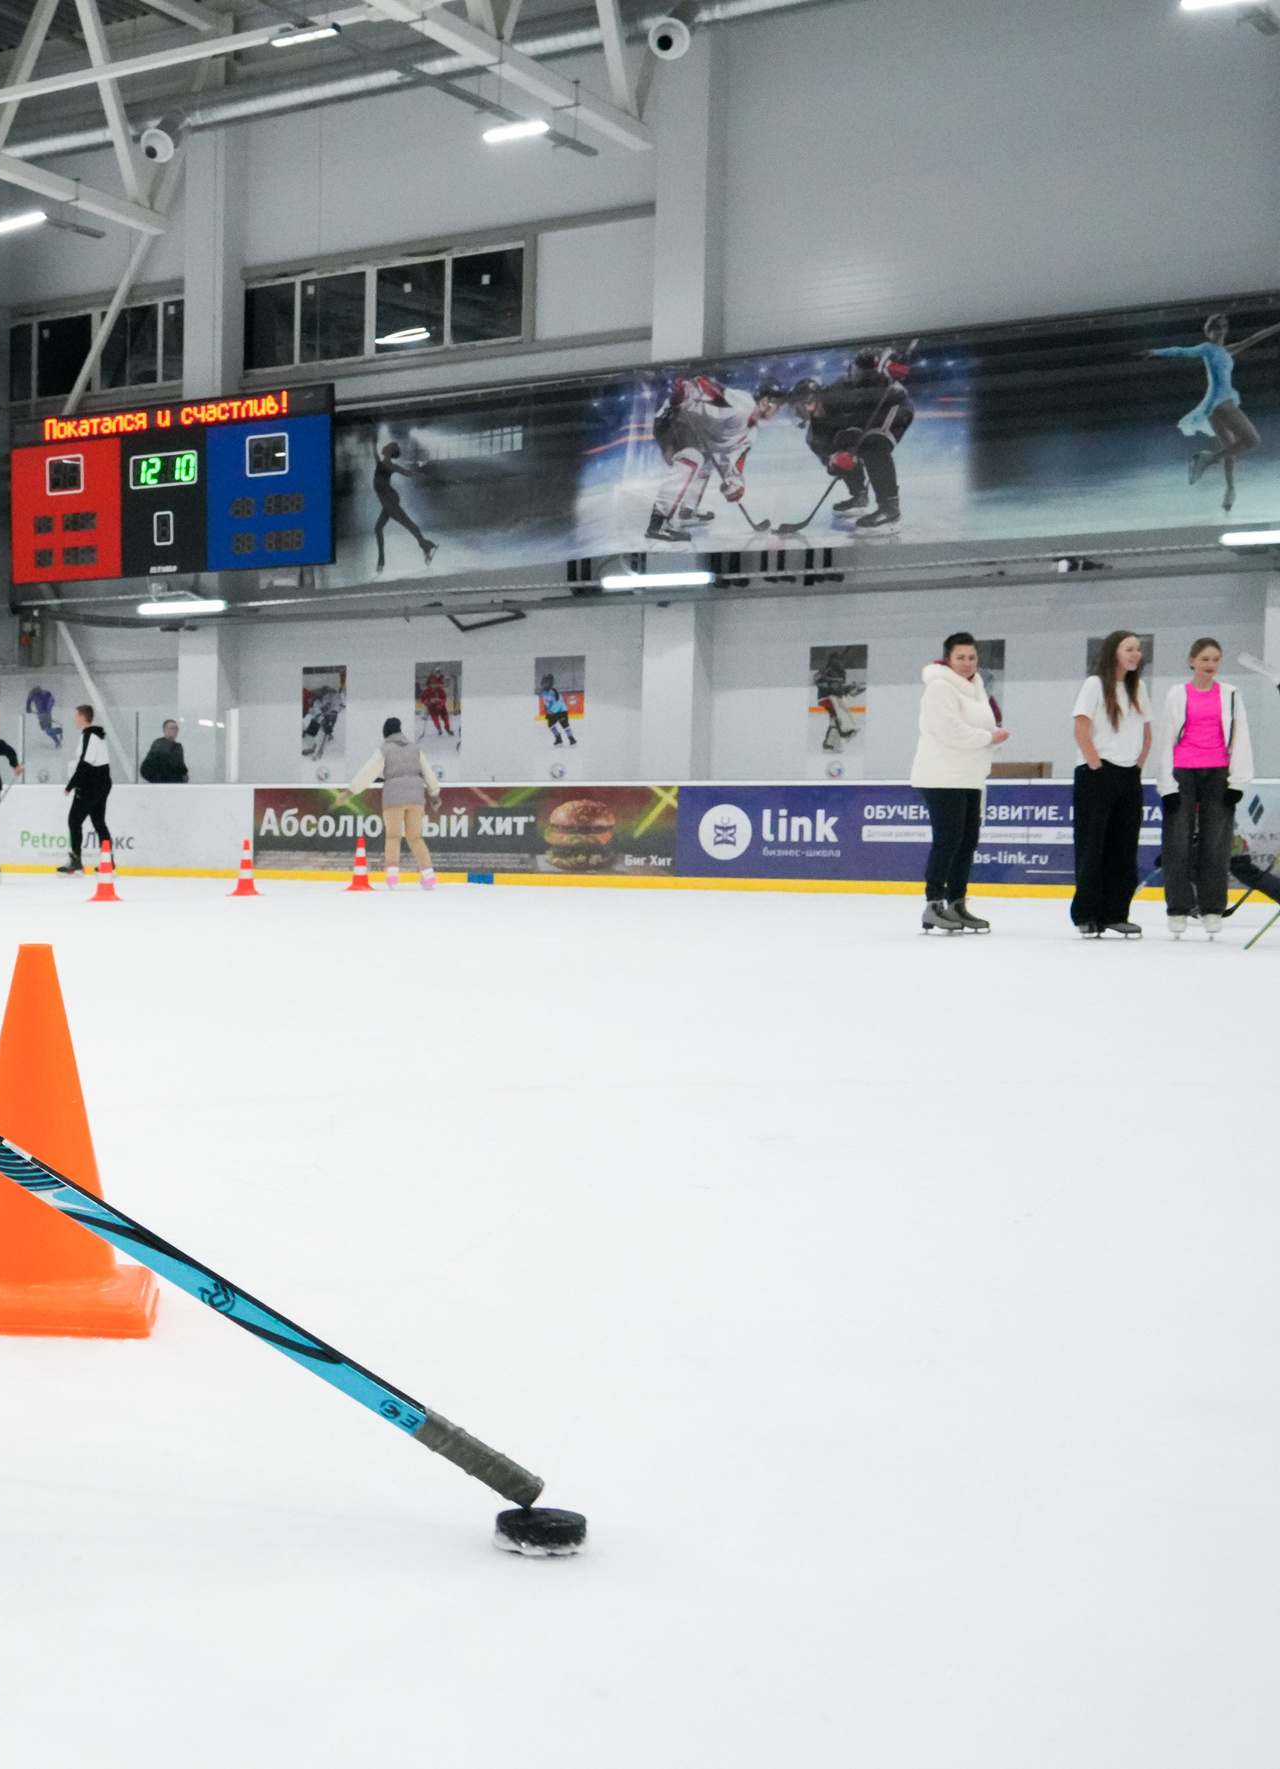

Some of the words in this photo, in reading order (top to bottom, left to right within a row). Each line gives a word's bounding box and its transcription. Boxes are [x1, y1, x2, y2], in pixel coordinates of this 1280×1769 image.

[43, 411, 148, 441] Покатался
[156, 409, 171, 429] и
[180, 389, 289, 426] счастлив!
[140, 457, 161, 485] 12
[174, 453, 195, 481] 10
[259, 806, 469, 838] Абсолюый
[762, 809, 839, 843] link
[83, 831, 134, 850] Лкс
[762, 847, 841, 858] бизнес-школа
[624, 854, 647, 866] Биг
[649, 854, 673, 867] Хит
